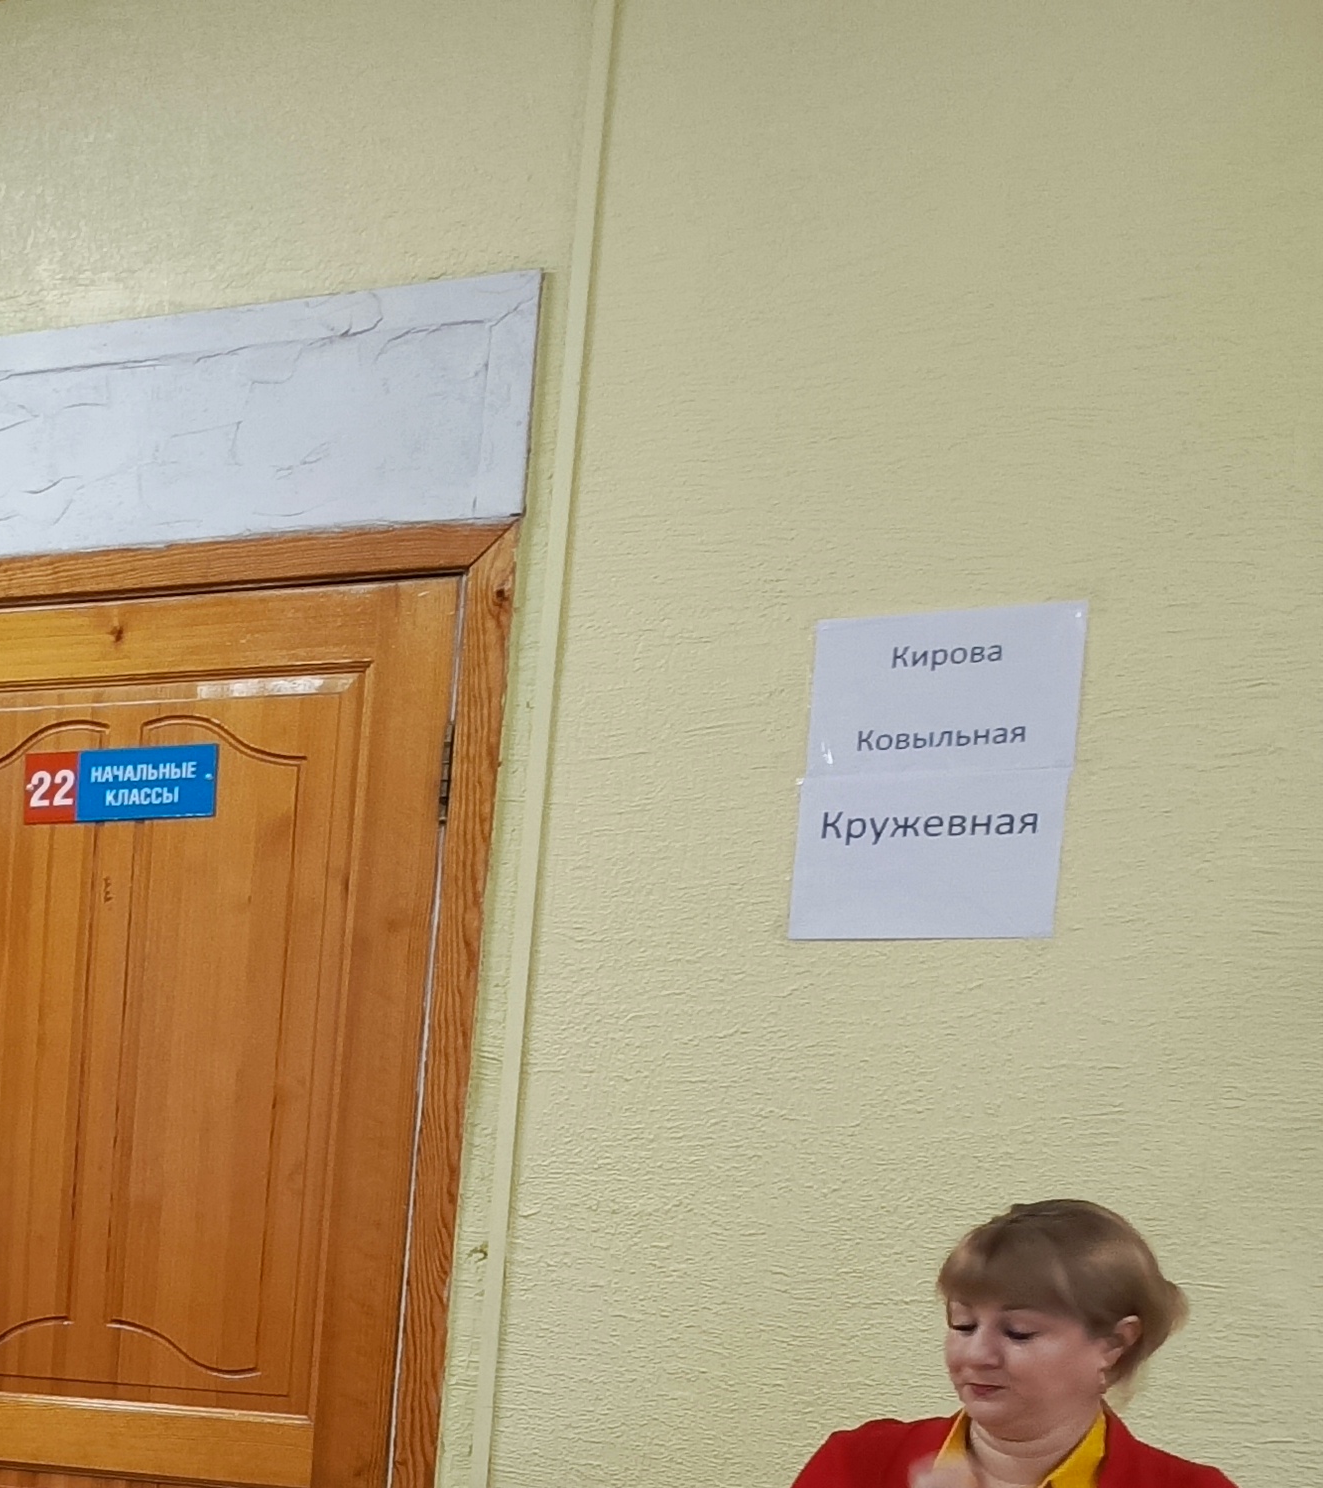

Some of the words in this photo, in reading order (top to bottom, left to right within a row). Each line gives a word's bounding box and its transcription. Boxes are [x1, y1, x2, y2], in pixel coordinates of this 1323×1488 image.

[891, 643, 1003, 671] Кирова
[856, 725, 1027, 752] Ковыльная
[90, 761, 197, 783] НАЧАЛЬНЫЕ
[29, 769, 75, 808] 22
[105, 786, 179, 806] КЛАССЫ
[820, 811, 1040, 846] Кружевная
